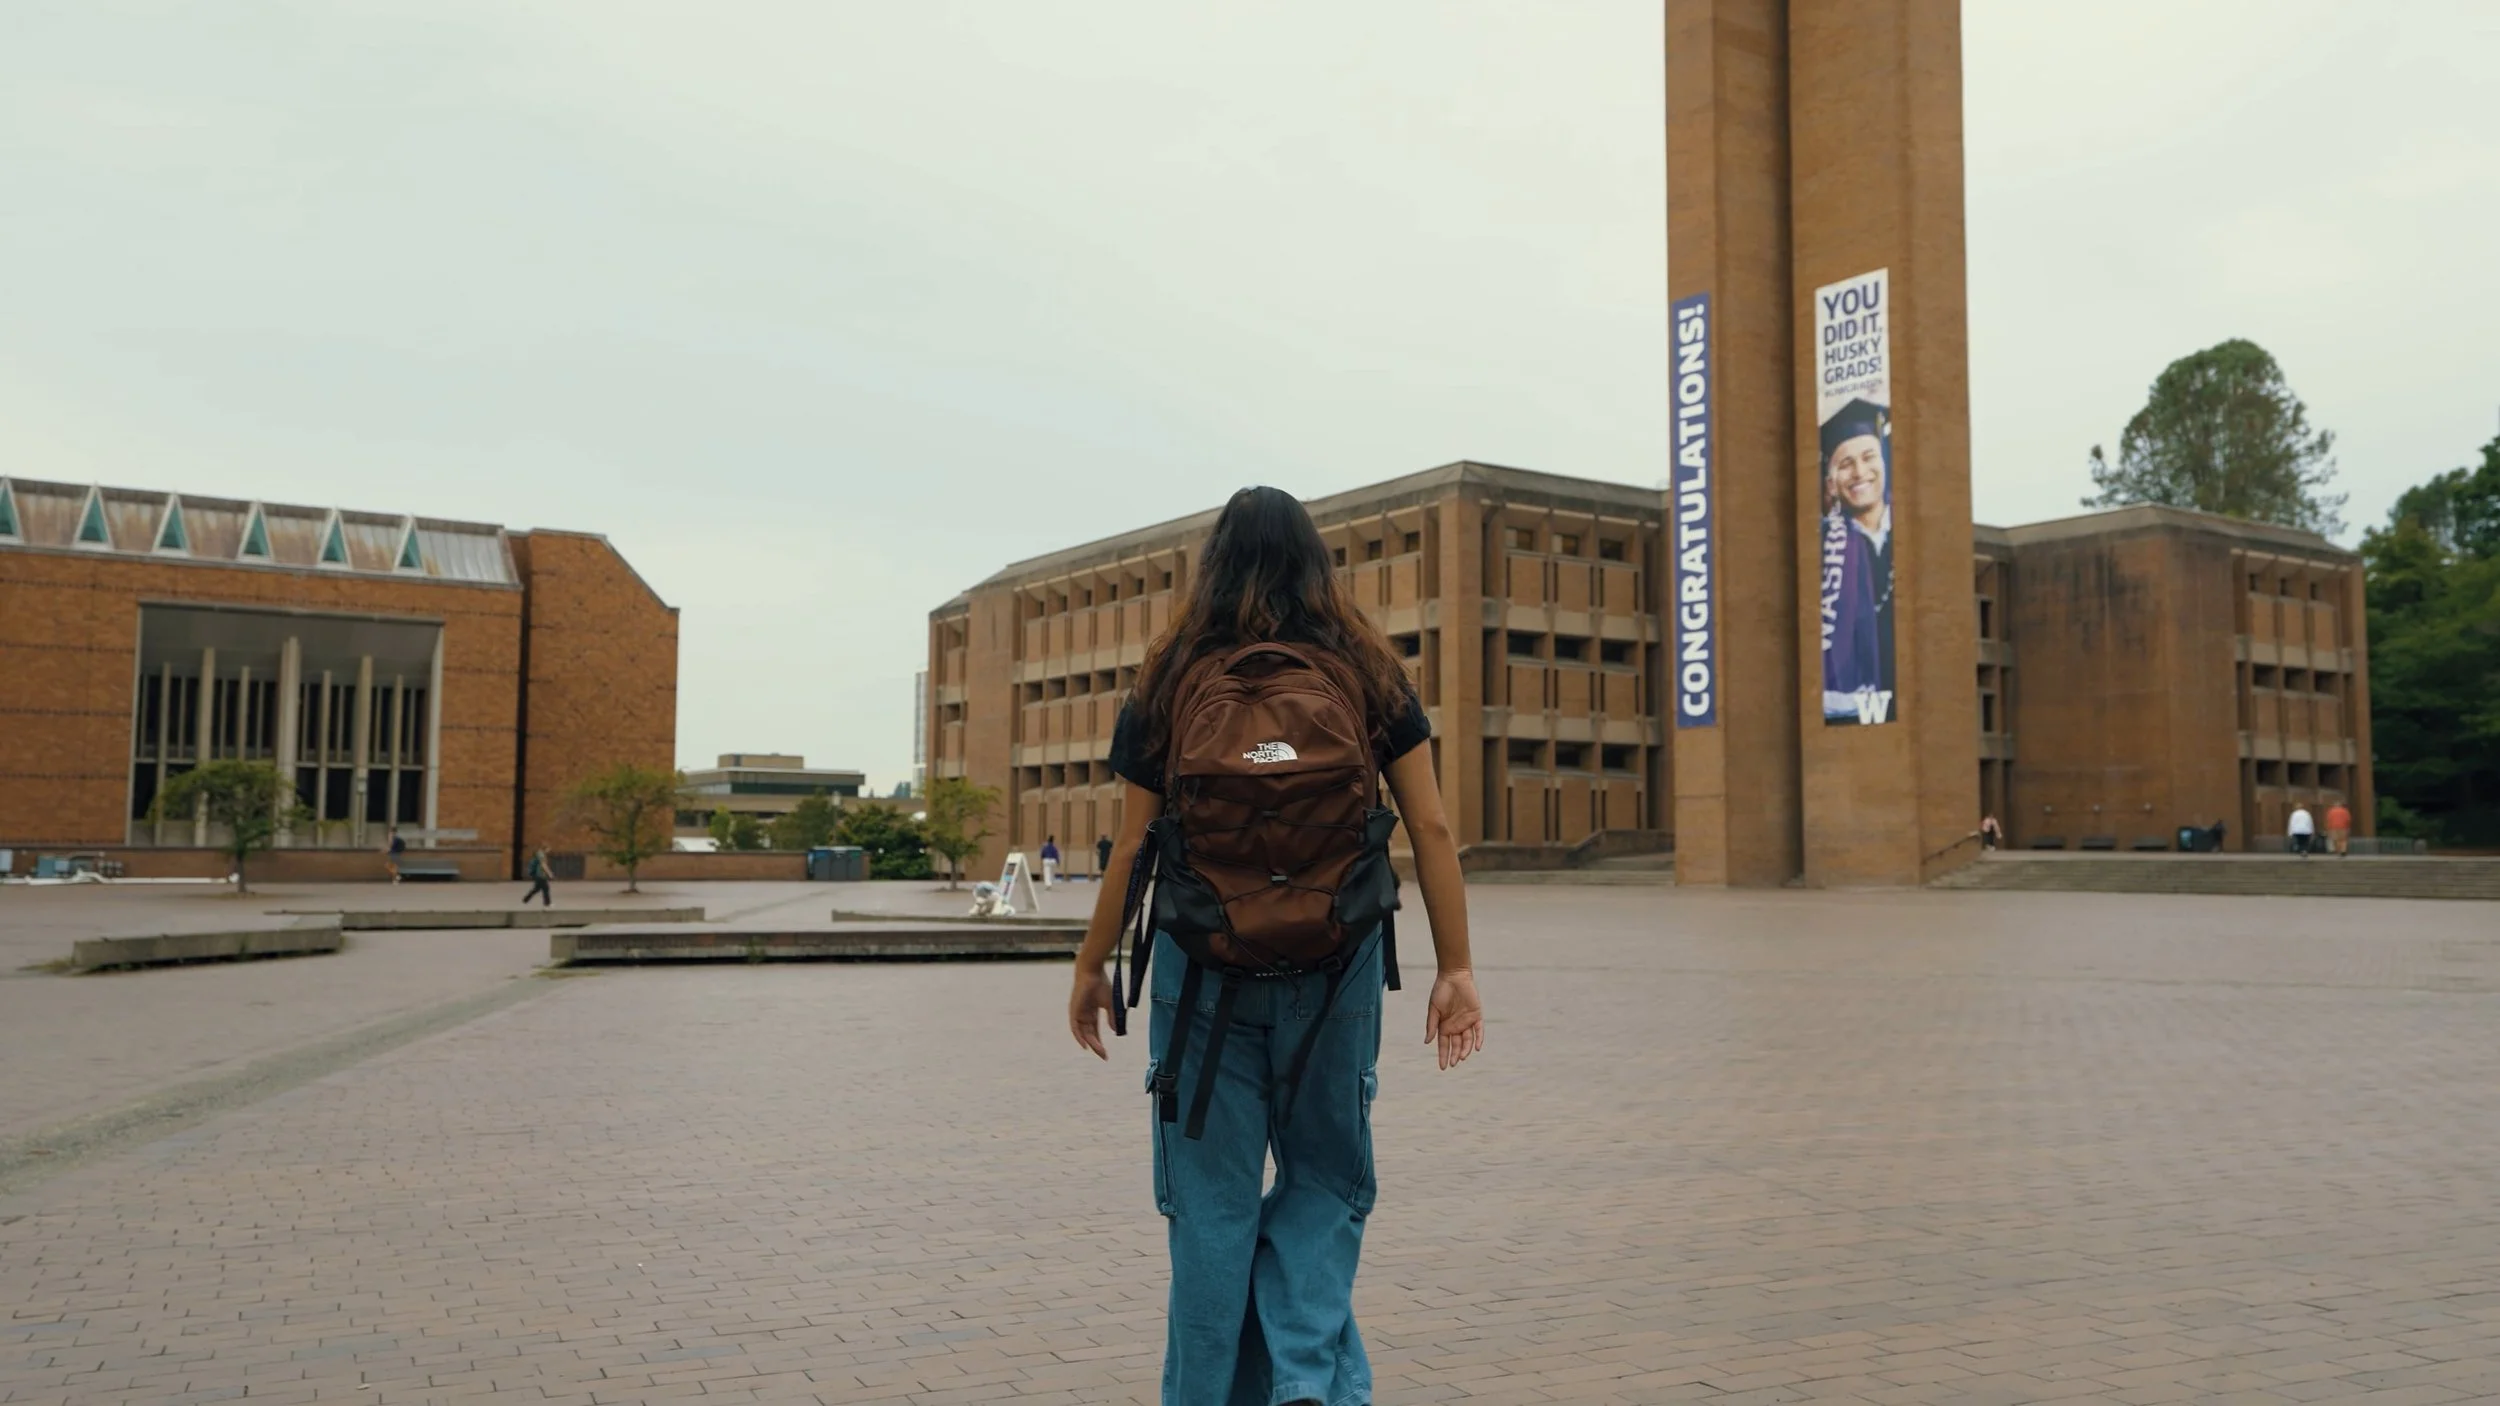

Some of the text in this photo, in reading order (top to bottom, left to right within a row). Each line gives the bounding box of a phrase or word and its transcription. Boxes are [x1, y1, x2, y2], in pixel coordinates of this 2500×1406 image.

[1823, 281, 1880, 320] YOU
[1824, 319, 1857, 346] DID
[1824, 336, 1881, 366] HUSKY
[1824, 356, 1882, 385] GRADS!
[1678, 303, 1709, 716] CONGRATULATIONS!
[1854, 690, 1893, 725] W
[1242, 750, 1279, 759] NORTH
[1257, 743, 1279, 751] THE
